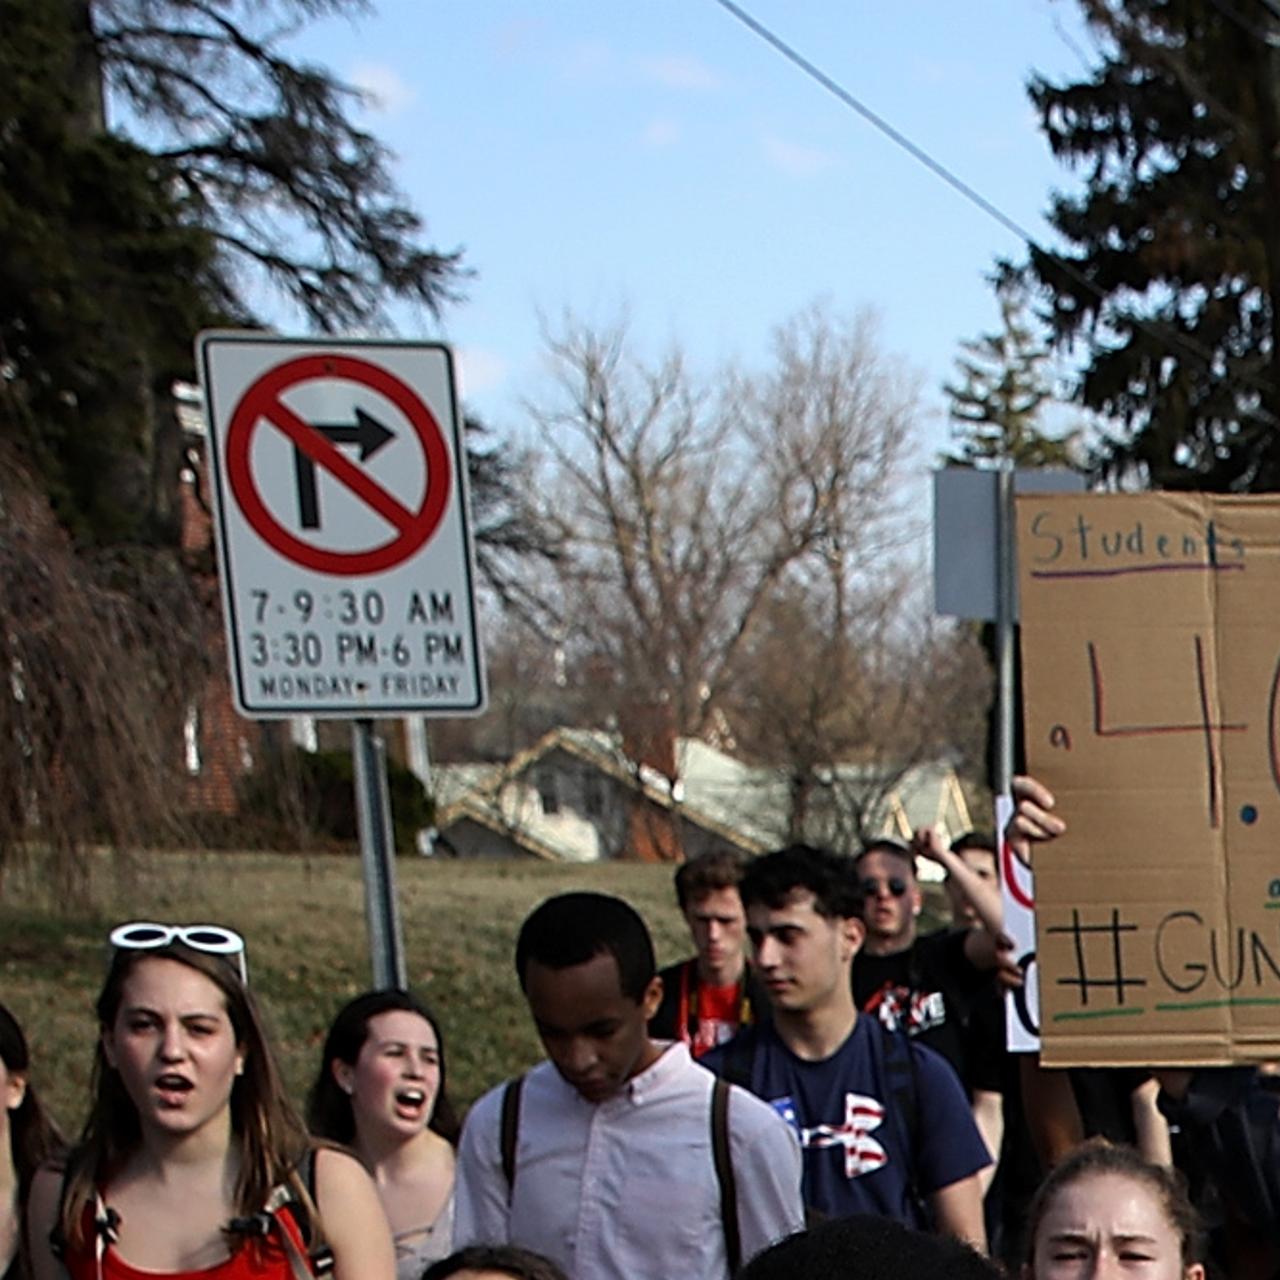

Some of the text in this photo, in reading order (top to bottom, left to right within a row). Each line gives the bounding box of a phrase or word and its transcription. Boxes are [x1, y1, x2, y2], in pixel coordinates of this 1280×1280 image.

[1031, 511, 1246, 567] Students
[251, 589, 454, 625] 7-9:30 AM
[250, 633, 322, 666] 3:30
[425, 634, 465, 665] PM
[381, 673, 461, 696] FRIDAY
[1049, 724, 1071, 750] a
